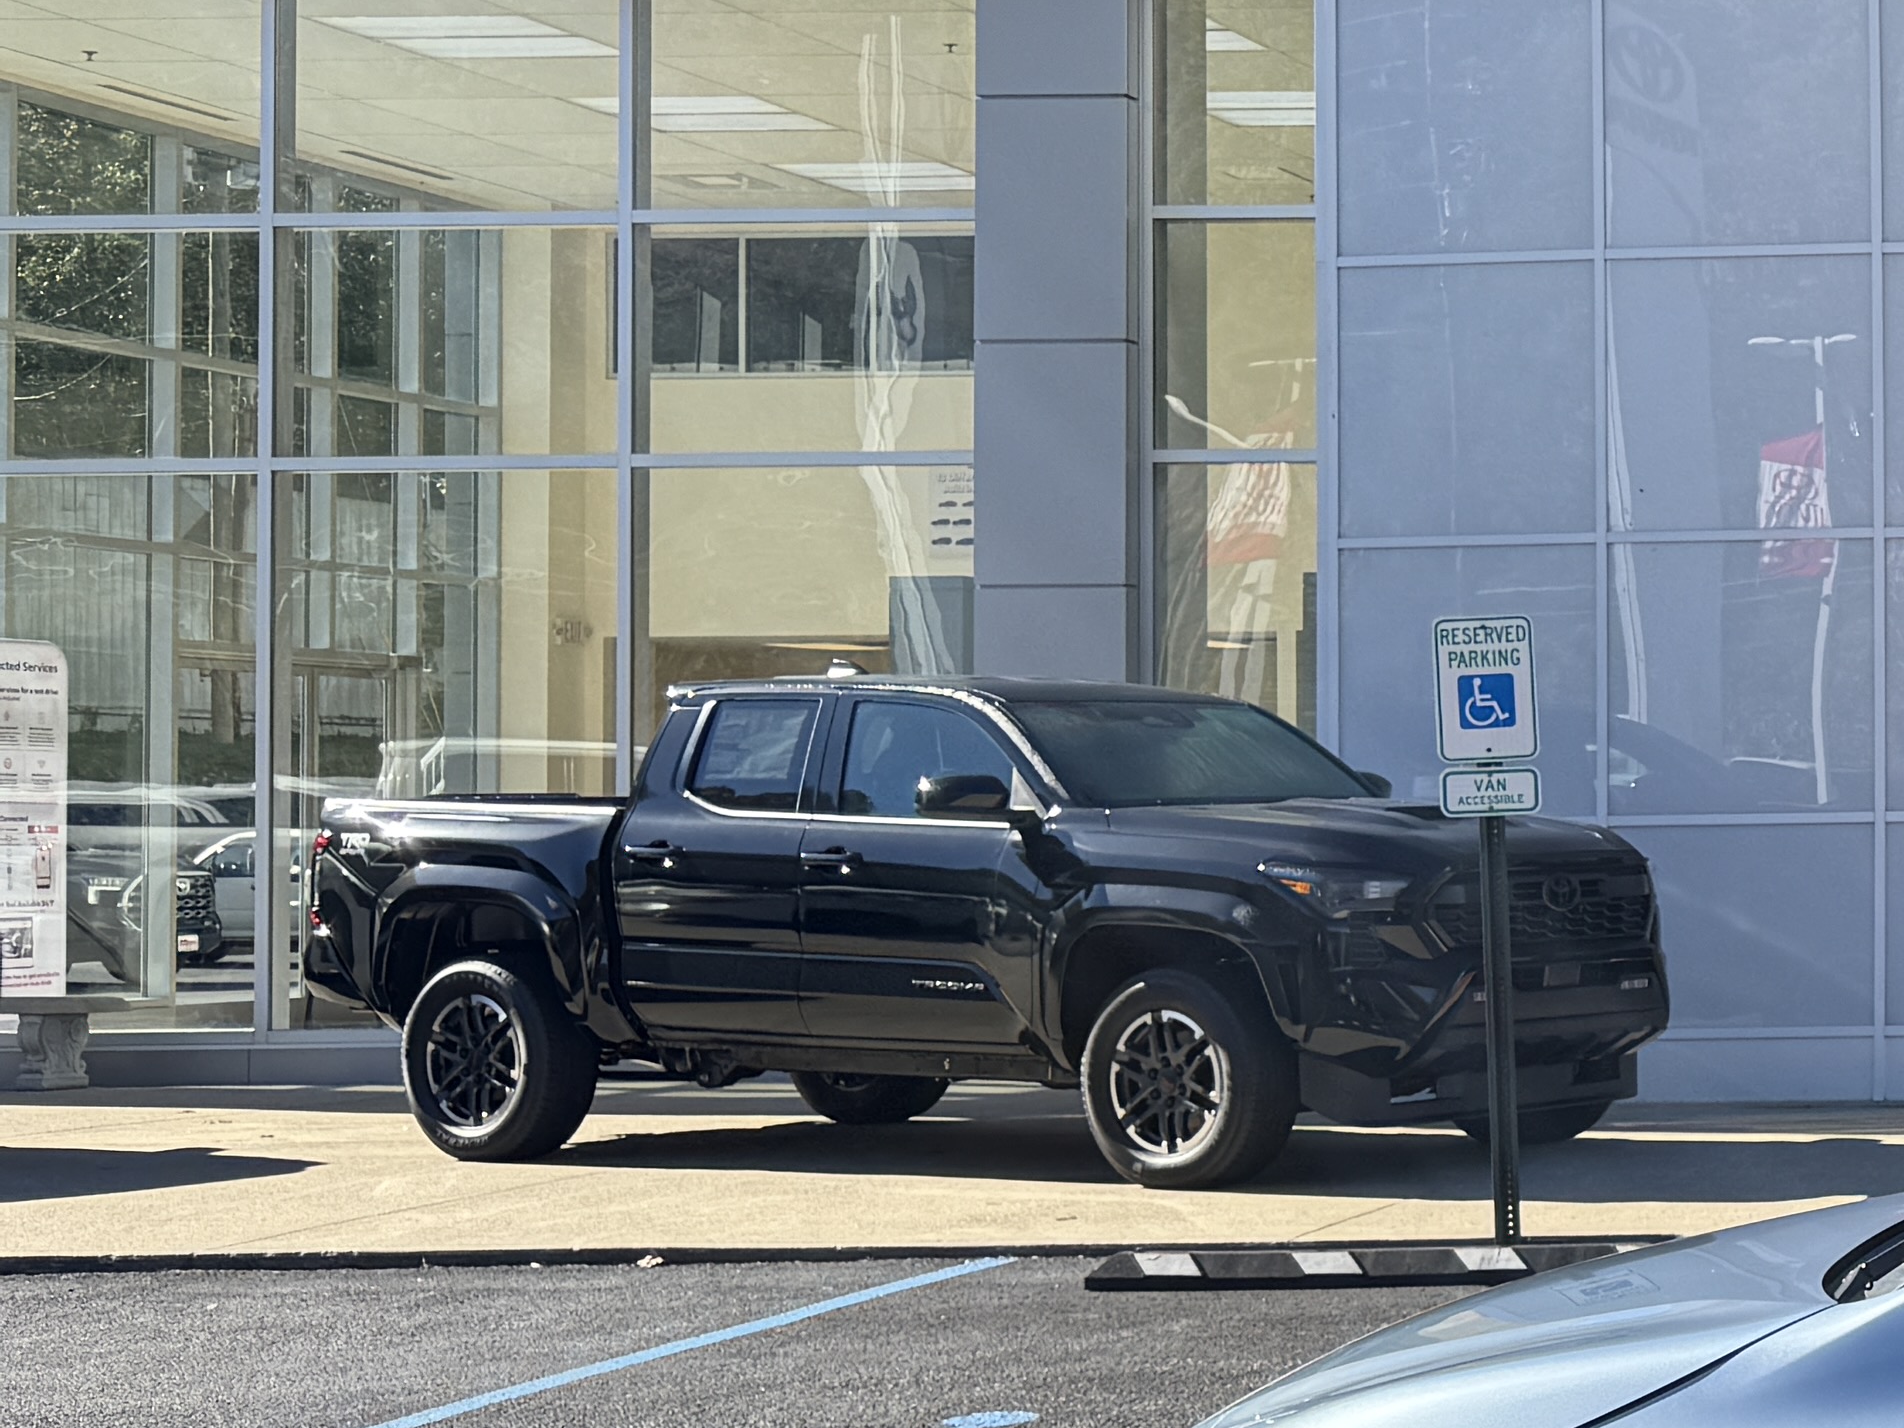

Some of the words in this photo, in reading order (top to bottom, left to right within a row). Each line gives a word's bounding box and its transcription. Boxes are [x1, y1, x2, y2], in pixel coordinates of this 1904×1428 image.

[1440, 625, 1526, 646] RESERVED
[1448, 649, 1521, 669] PARKING
[1474, 779, 1506, 792] VAN
[1458, 793, 1524, 807] ACCESSIBLE
